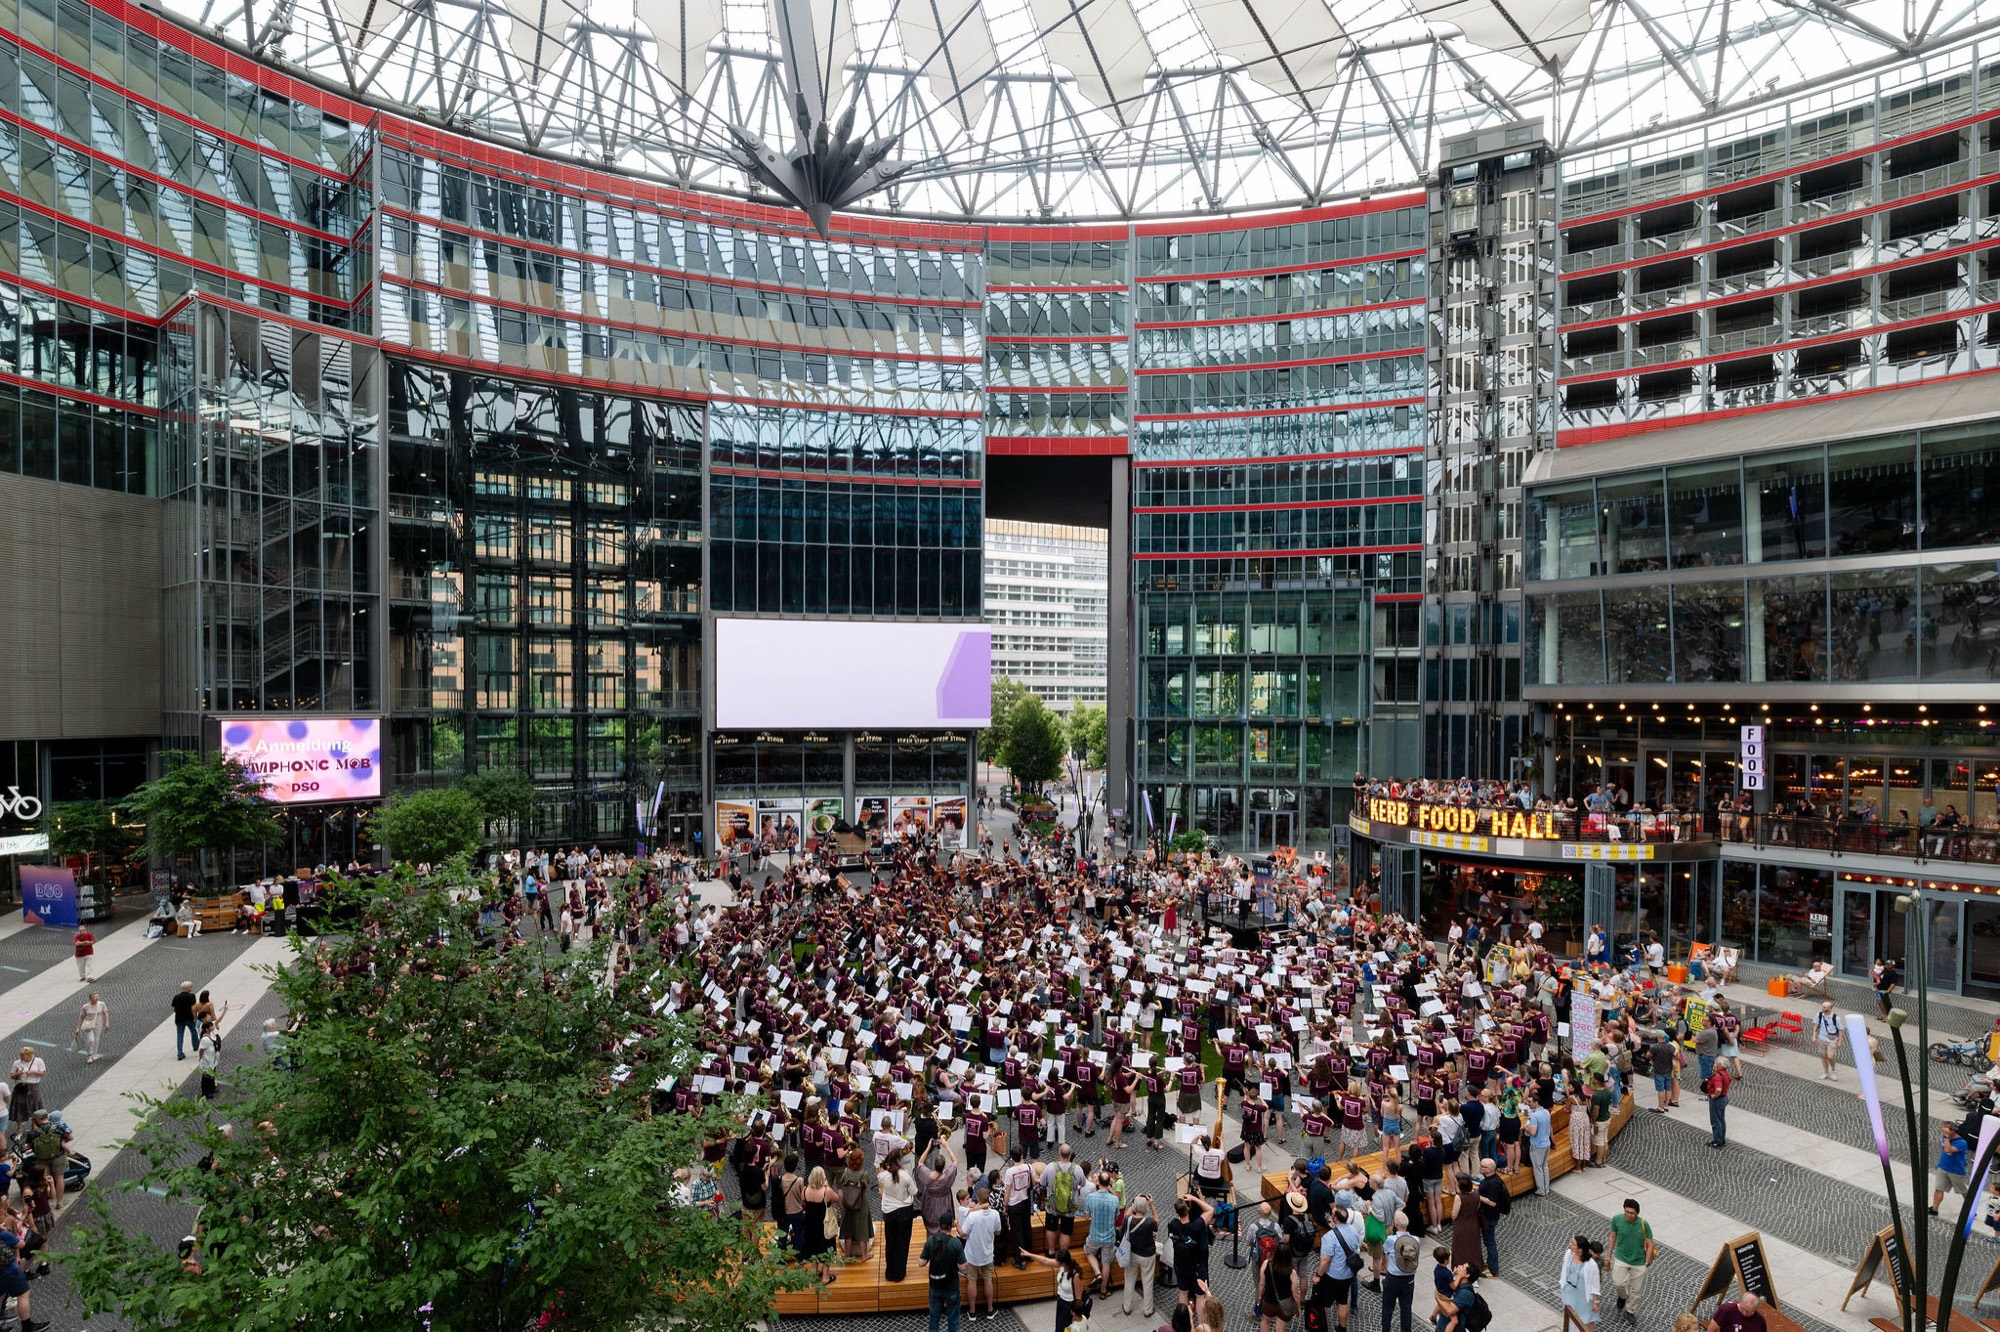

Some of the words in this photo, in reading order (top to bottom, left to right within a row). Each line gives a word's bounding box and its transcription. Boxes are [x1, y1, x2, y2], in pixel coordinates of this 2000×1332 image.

[256, 739, 352, 753] Anmeldung
[336, 758, 371, 769] MOB
[1748, 728, 1757, 787] FOOD
[292, 782, 319, 792] DSO
[1370, 798, 1409, 826] KERB
[1419, 804, 1476, 833] FOOD
[1491, 811, 1561, 839] HALL
[35, 883, 63, 898] DSO
[1809, 913, 1828, 922] KERB
